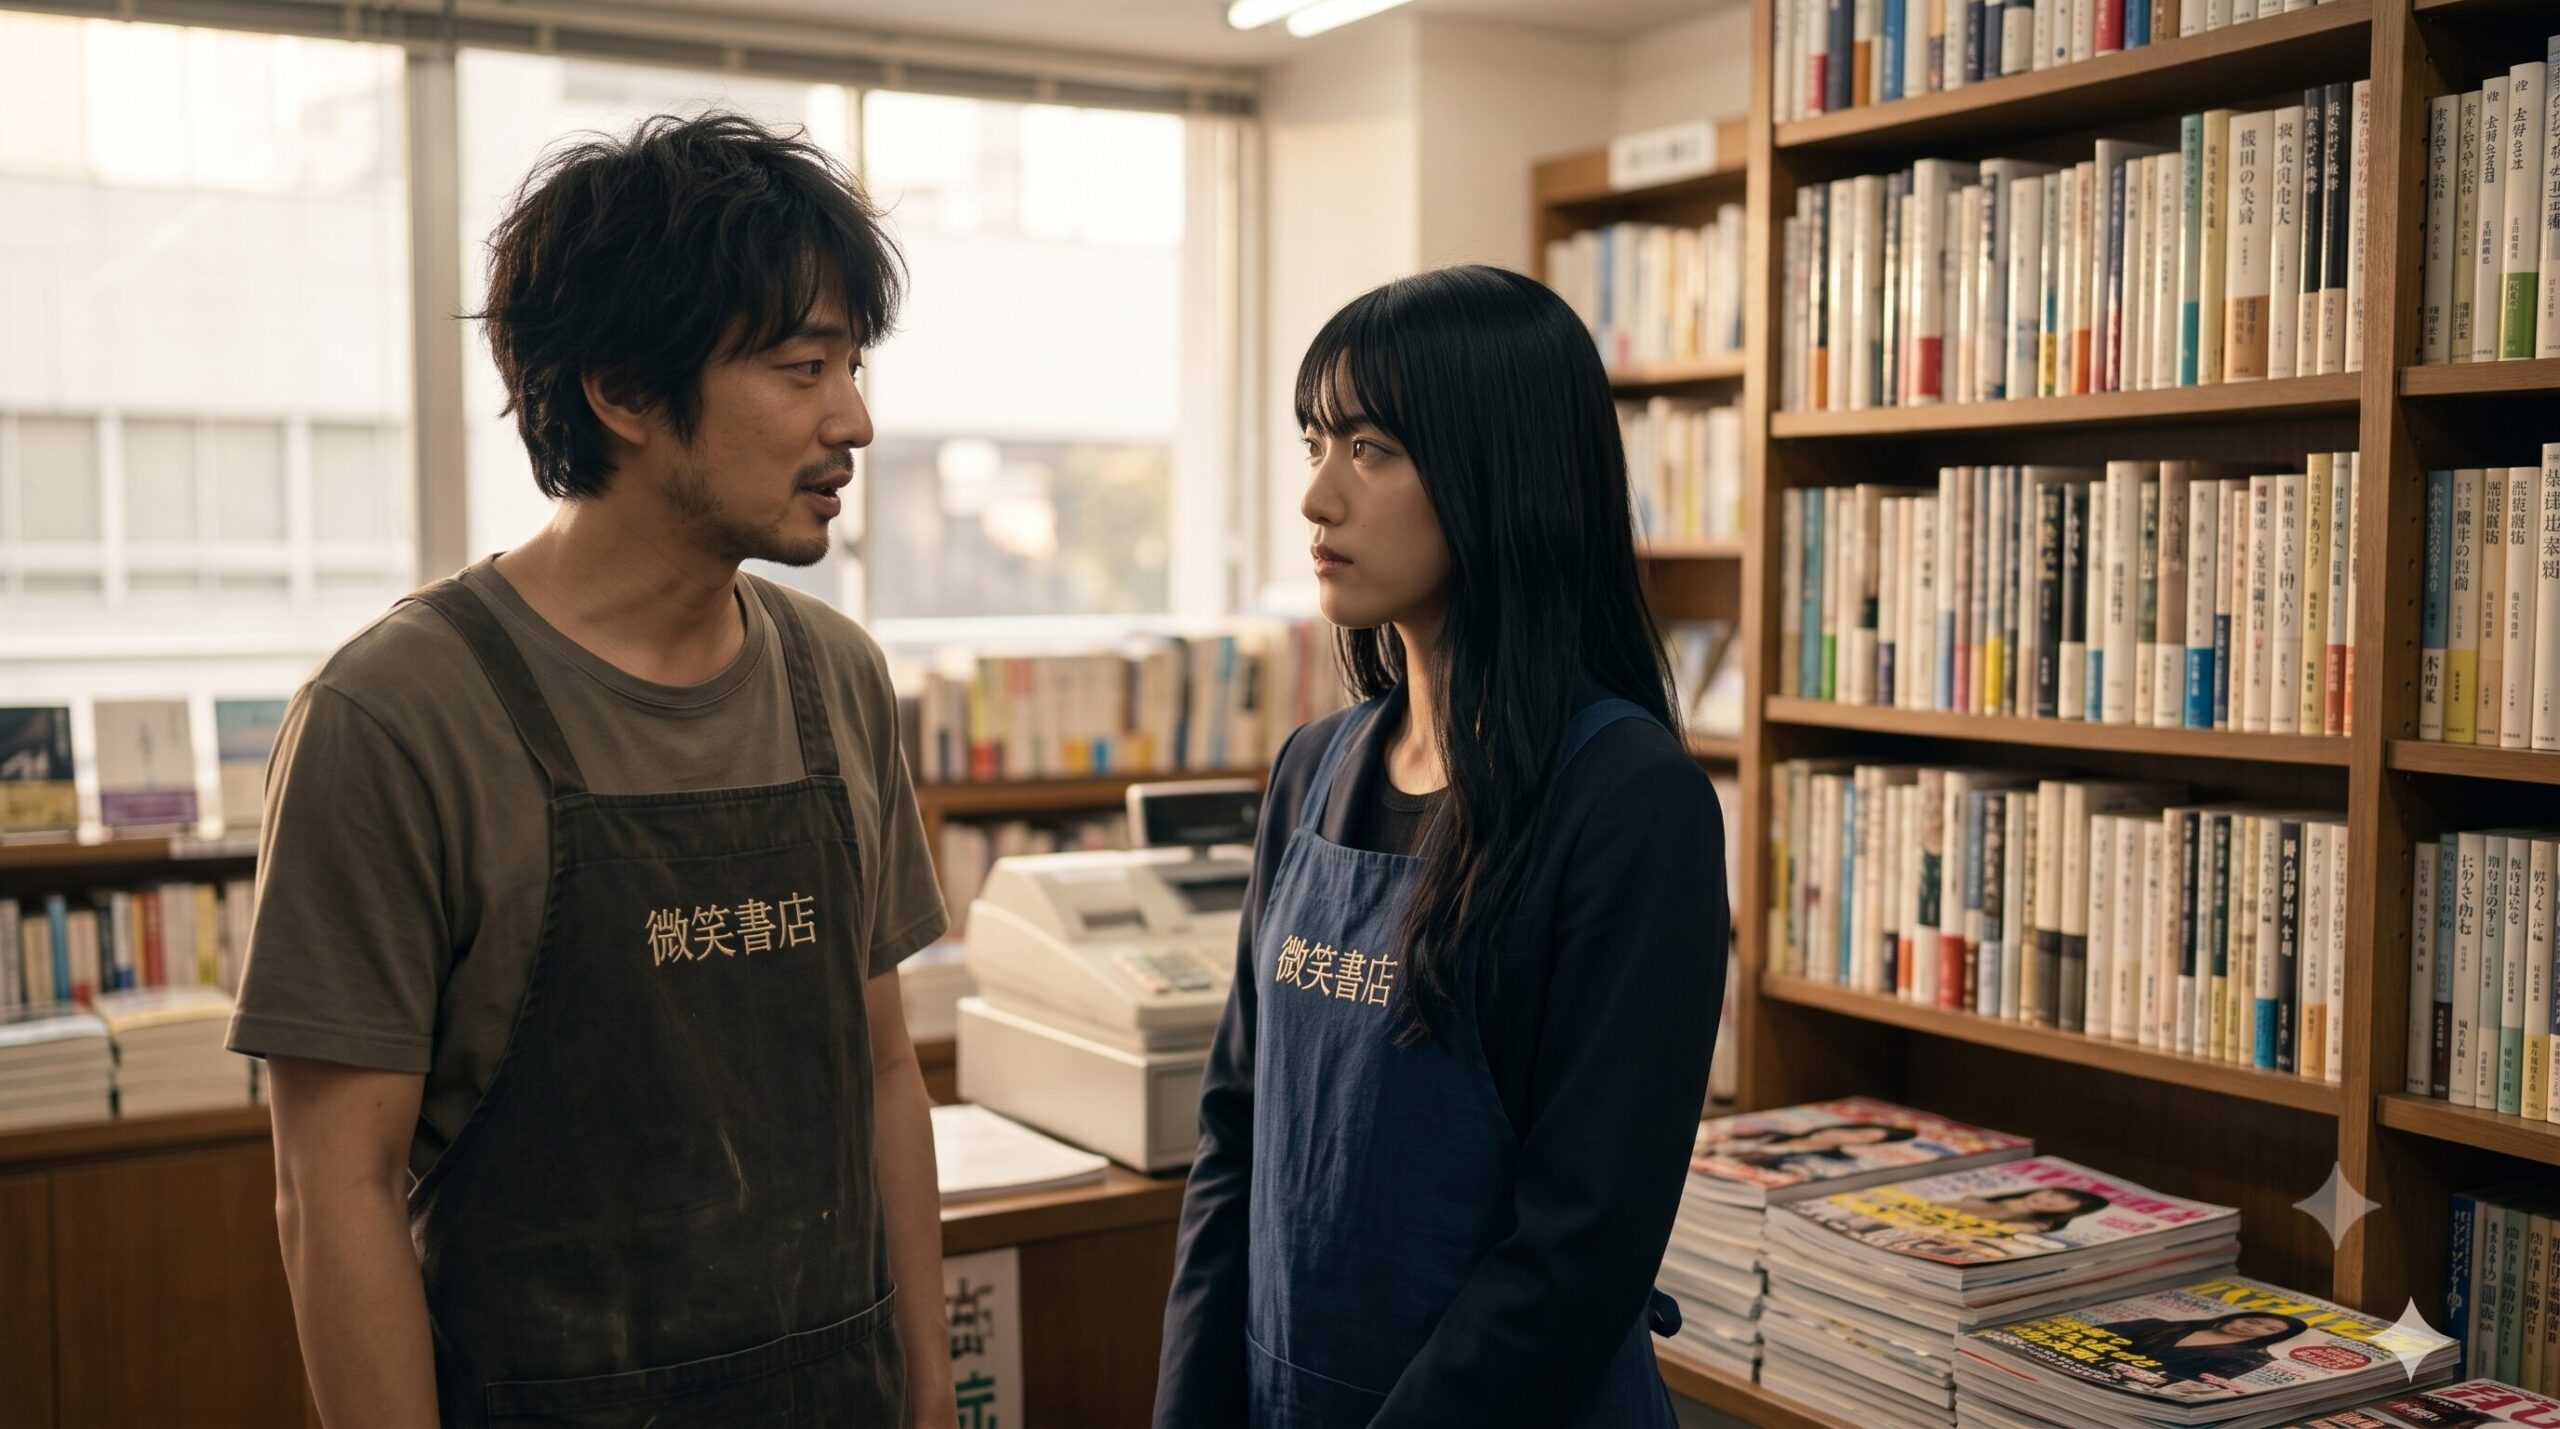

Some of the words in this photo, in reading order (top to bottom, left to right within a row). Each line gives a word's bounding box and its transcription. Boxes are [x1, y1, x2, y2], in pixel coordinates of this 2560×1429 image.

[645, 892, 817, 966] 微笑書店
[1275, 934, 1398, 1007] 微笑書店
